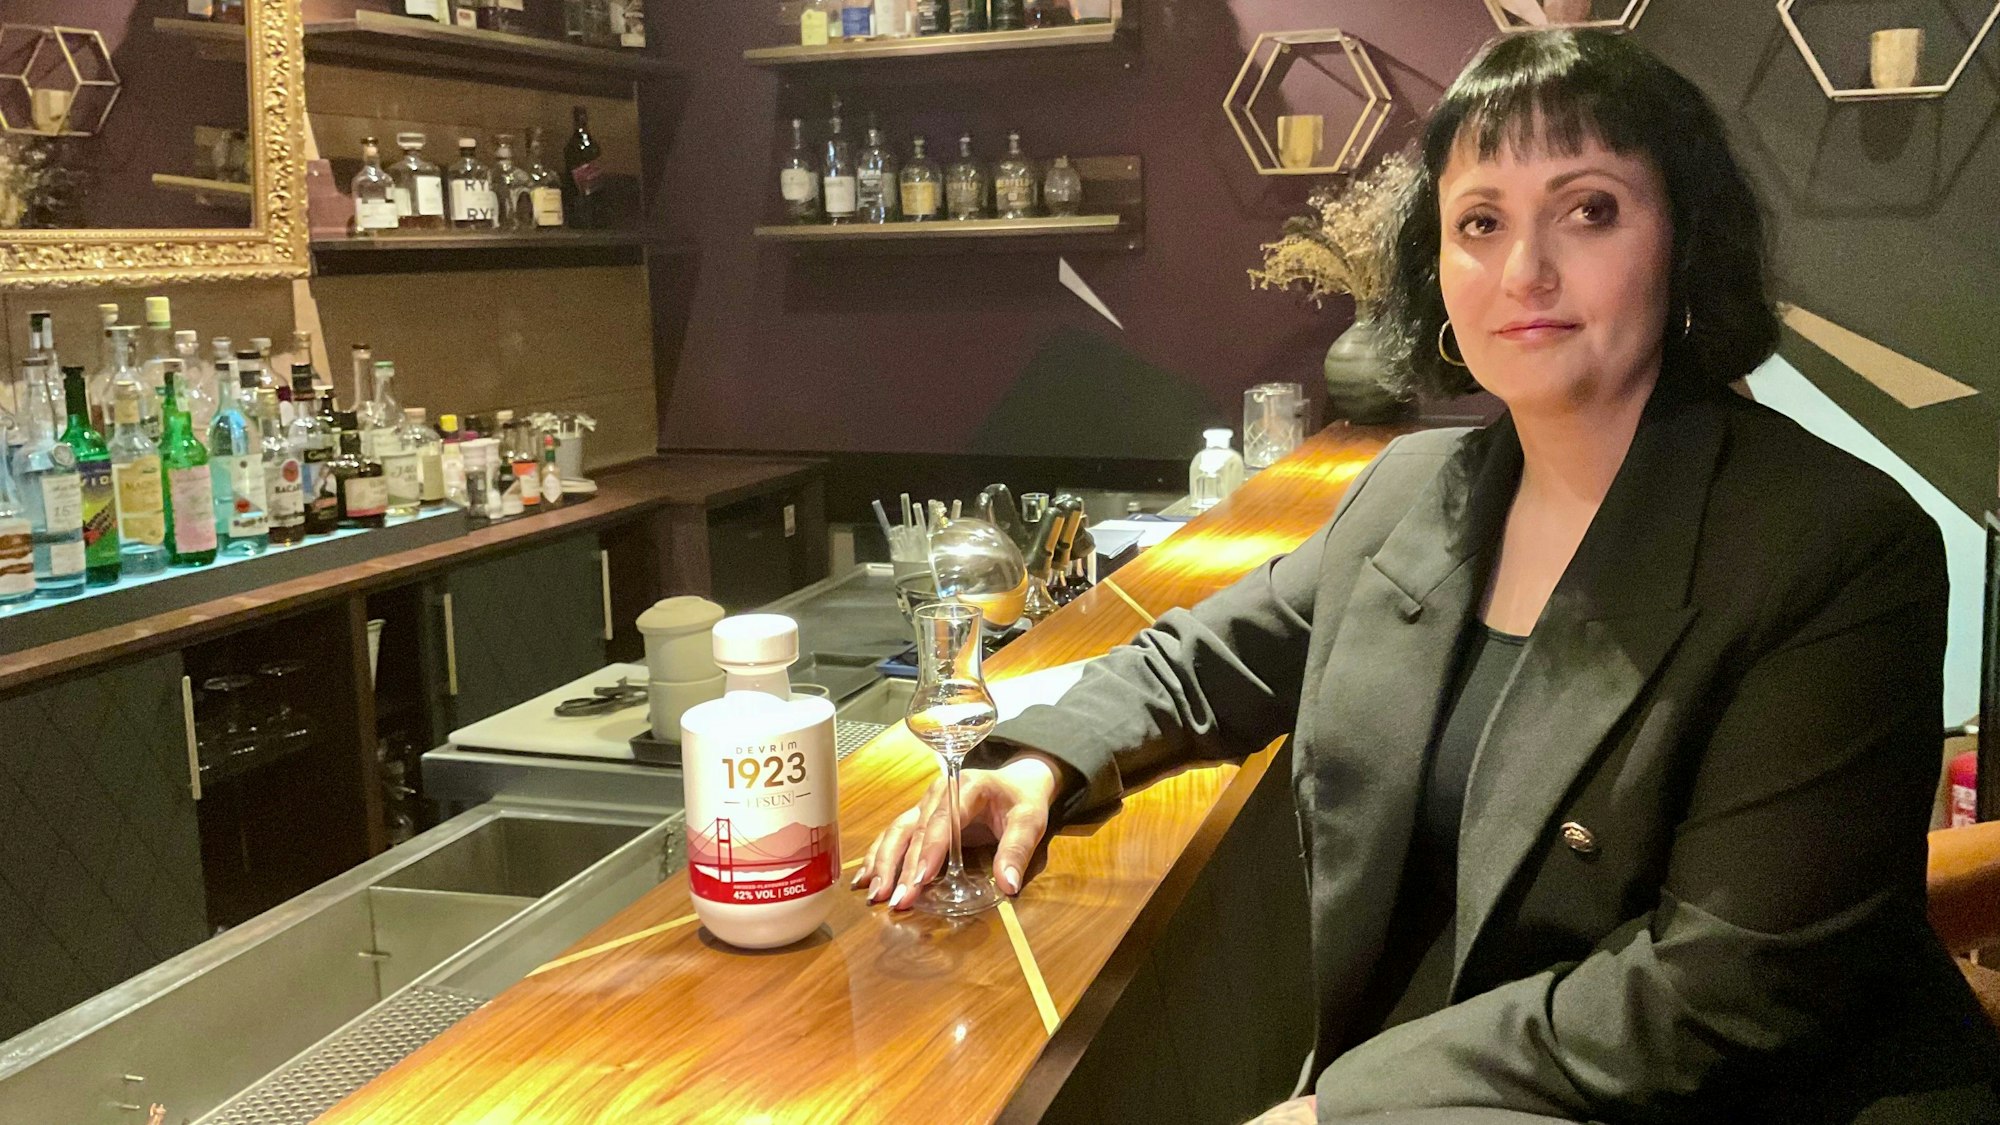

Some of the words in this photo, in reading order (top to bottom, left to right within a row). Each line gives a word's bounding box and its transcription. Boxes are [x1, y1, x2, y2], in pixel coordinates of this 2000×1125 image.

[722, 752, 806, 789] 1923
[733, 890, 754, 900] 42%
[754, 889, 777, 899] VOL
[783, 884, 807, 896] 50CL
